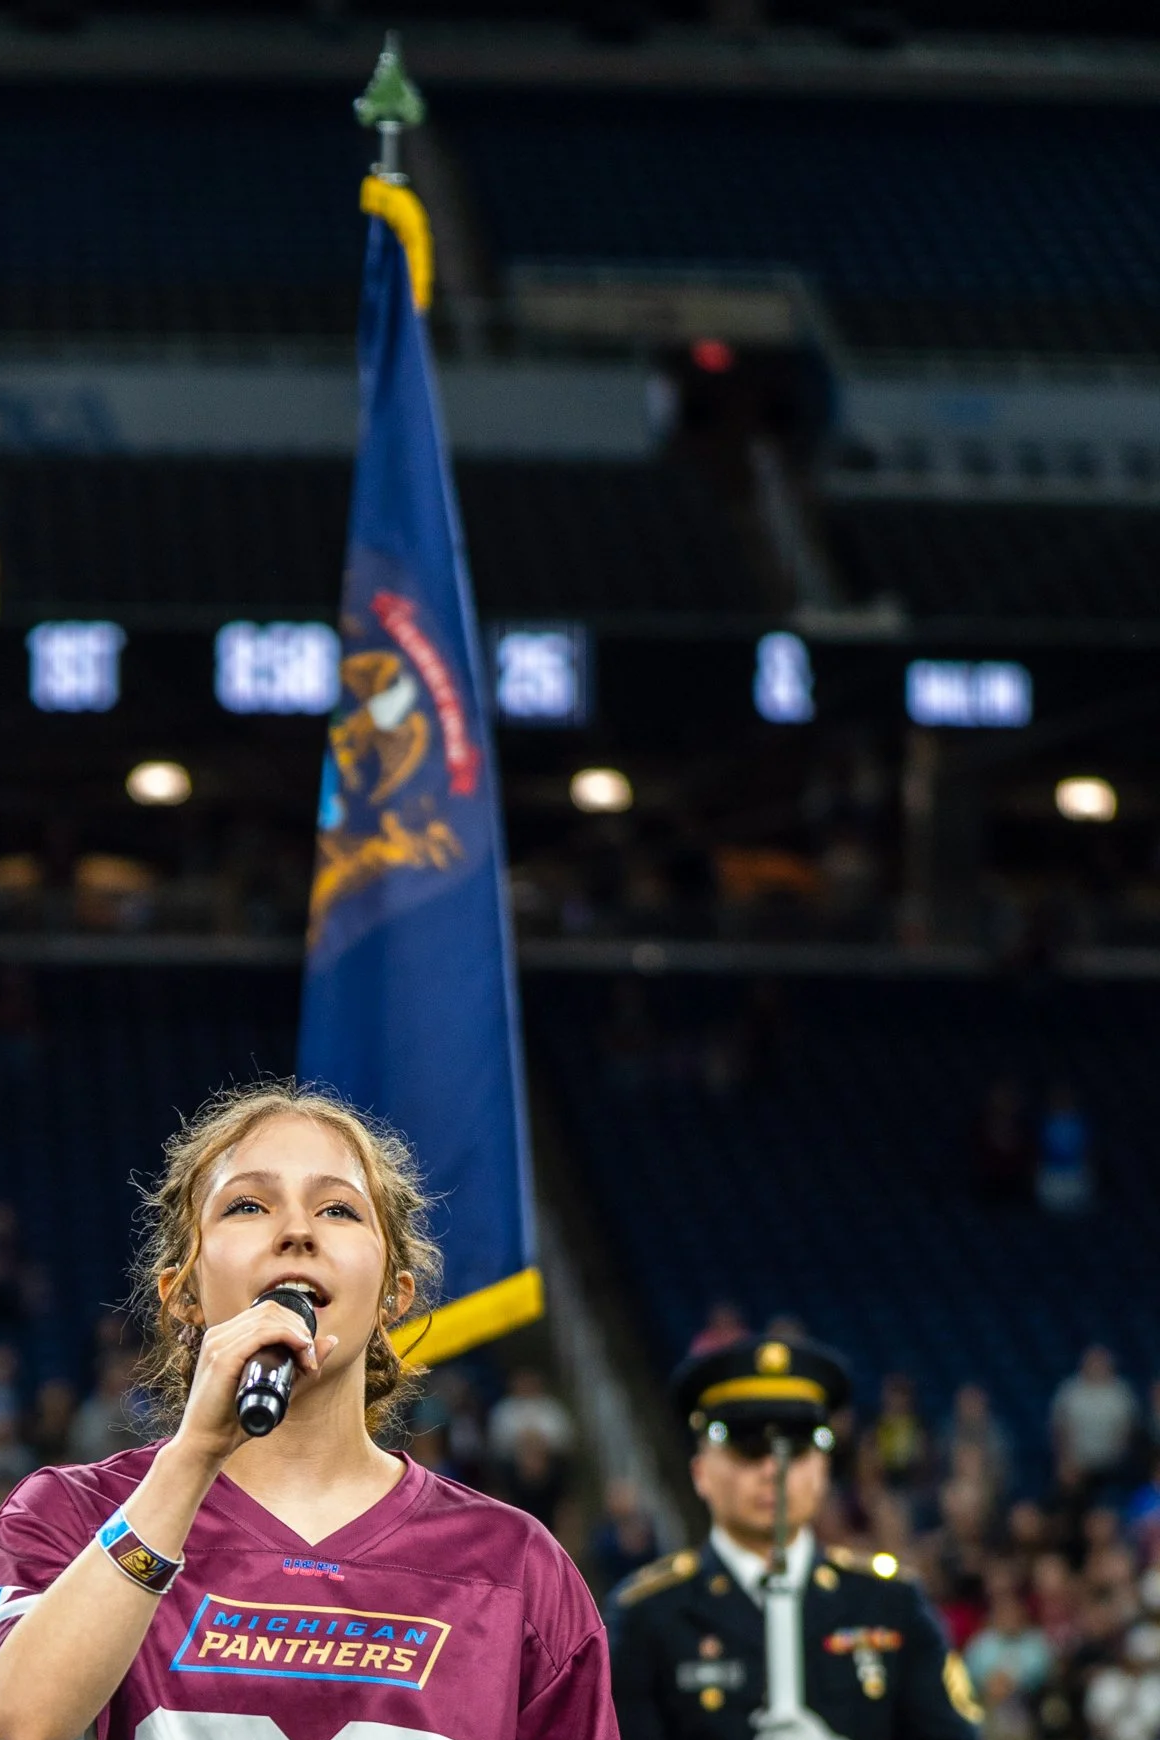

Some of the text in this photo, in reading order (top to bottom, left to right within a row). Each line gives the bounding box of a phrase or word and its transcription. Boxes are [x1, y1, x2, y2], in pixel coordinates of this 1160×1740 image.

[282, 1558, 345, 1581] USFL
[212, 1611, 428, 1645] MICHIGAN
[197, 1630, 418, 1673] PANTHERS
